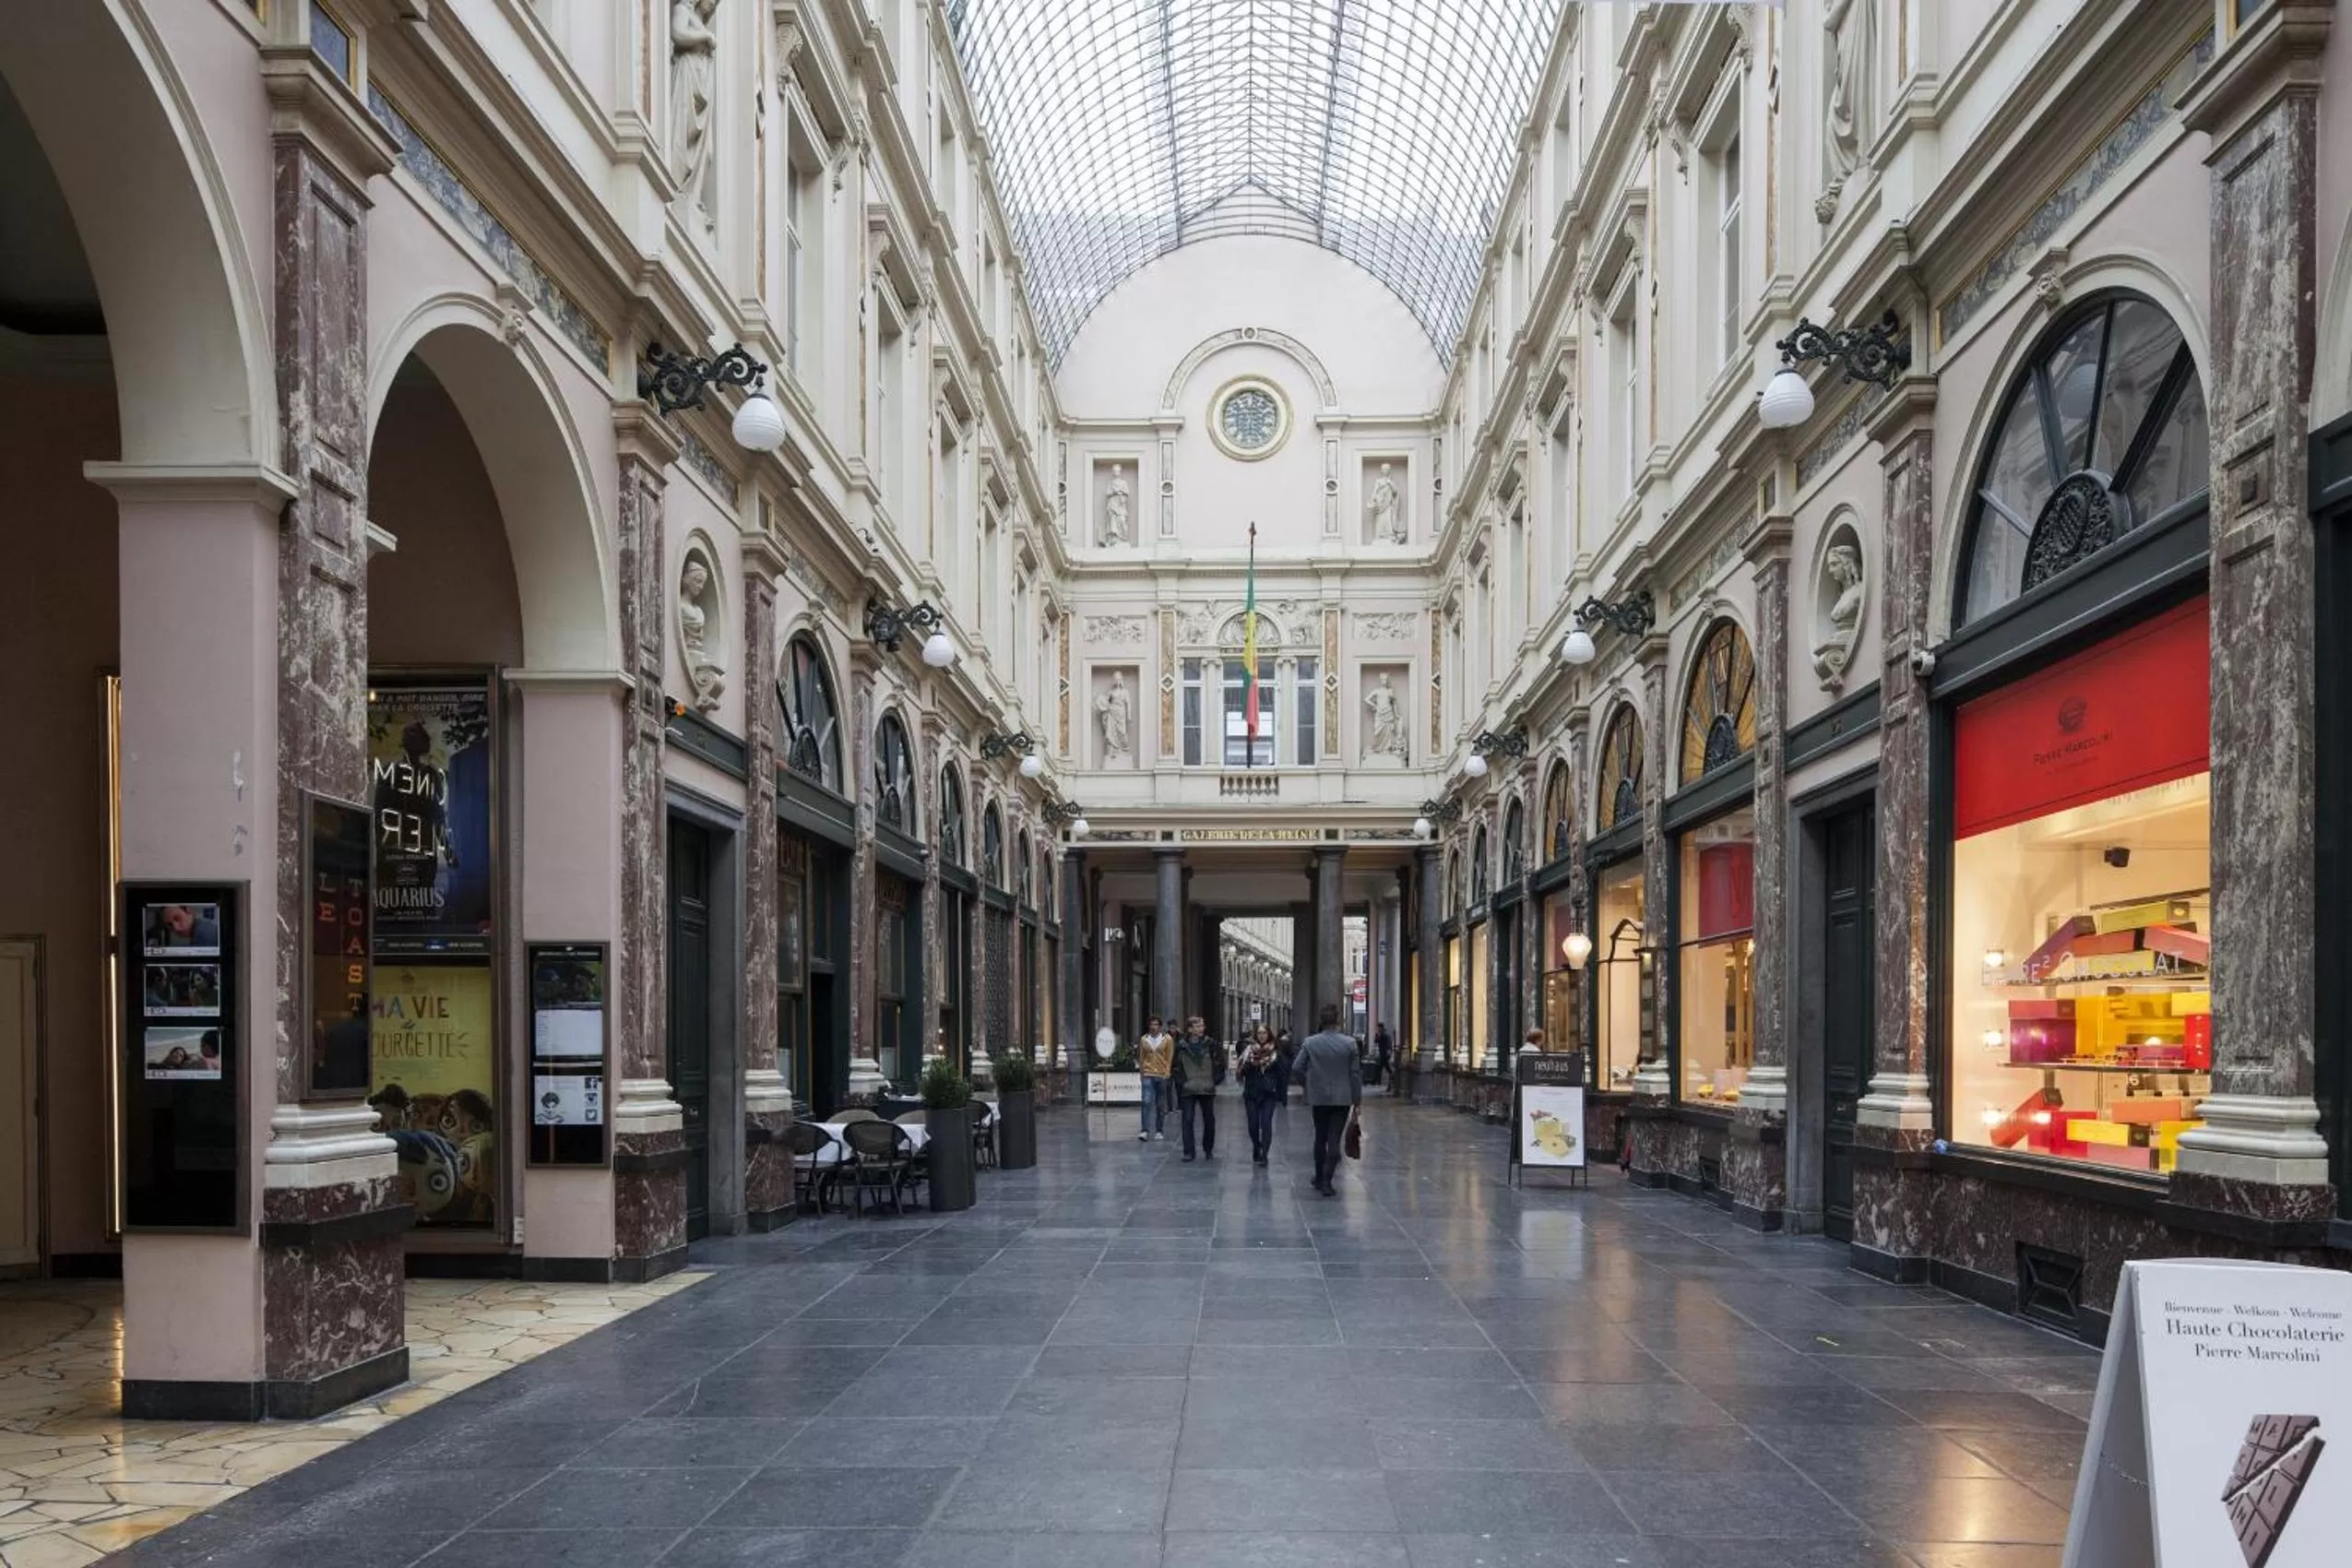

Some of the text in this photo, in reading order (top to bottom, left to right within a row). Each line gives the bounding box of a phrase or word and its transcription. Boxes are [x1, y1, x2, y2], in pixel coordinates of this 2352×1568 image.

[1183, 830, 1318, 840] GALERIE DE LA REINE
[411, 995, 450, 1019] VIE
[2165, 1301, 2343, 1320] Bienvenue Welkom Welcome
[2167, 1318, 2346, 1343] Haute Chocolaterie
[2194, 1343, 2322, 1363] Pierre Marcolini
